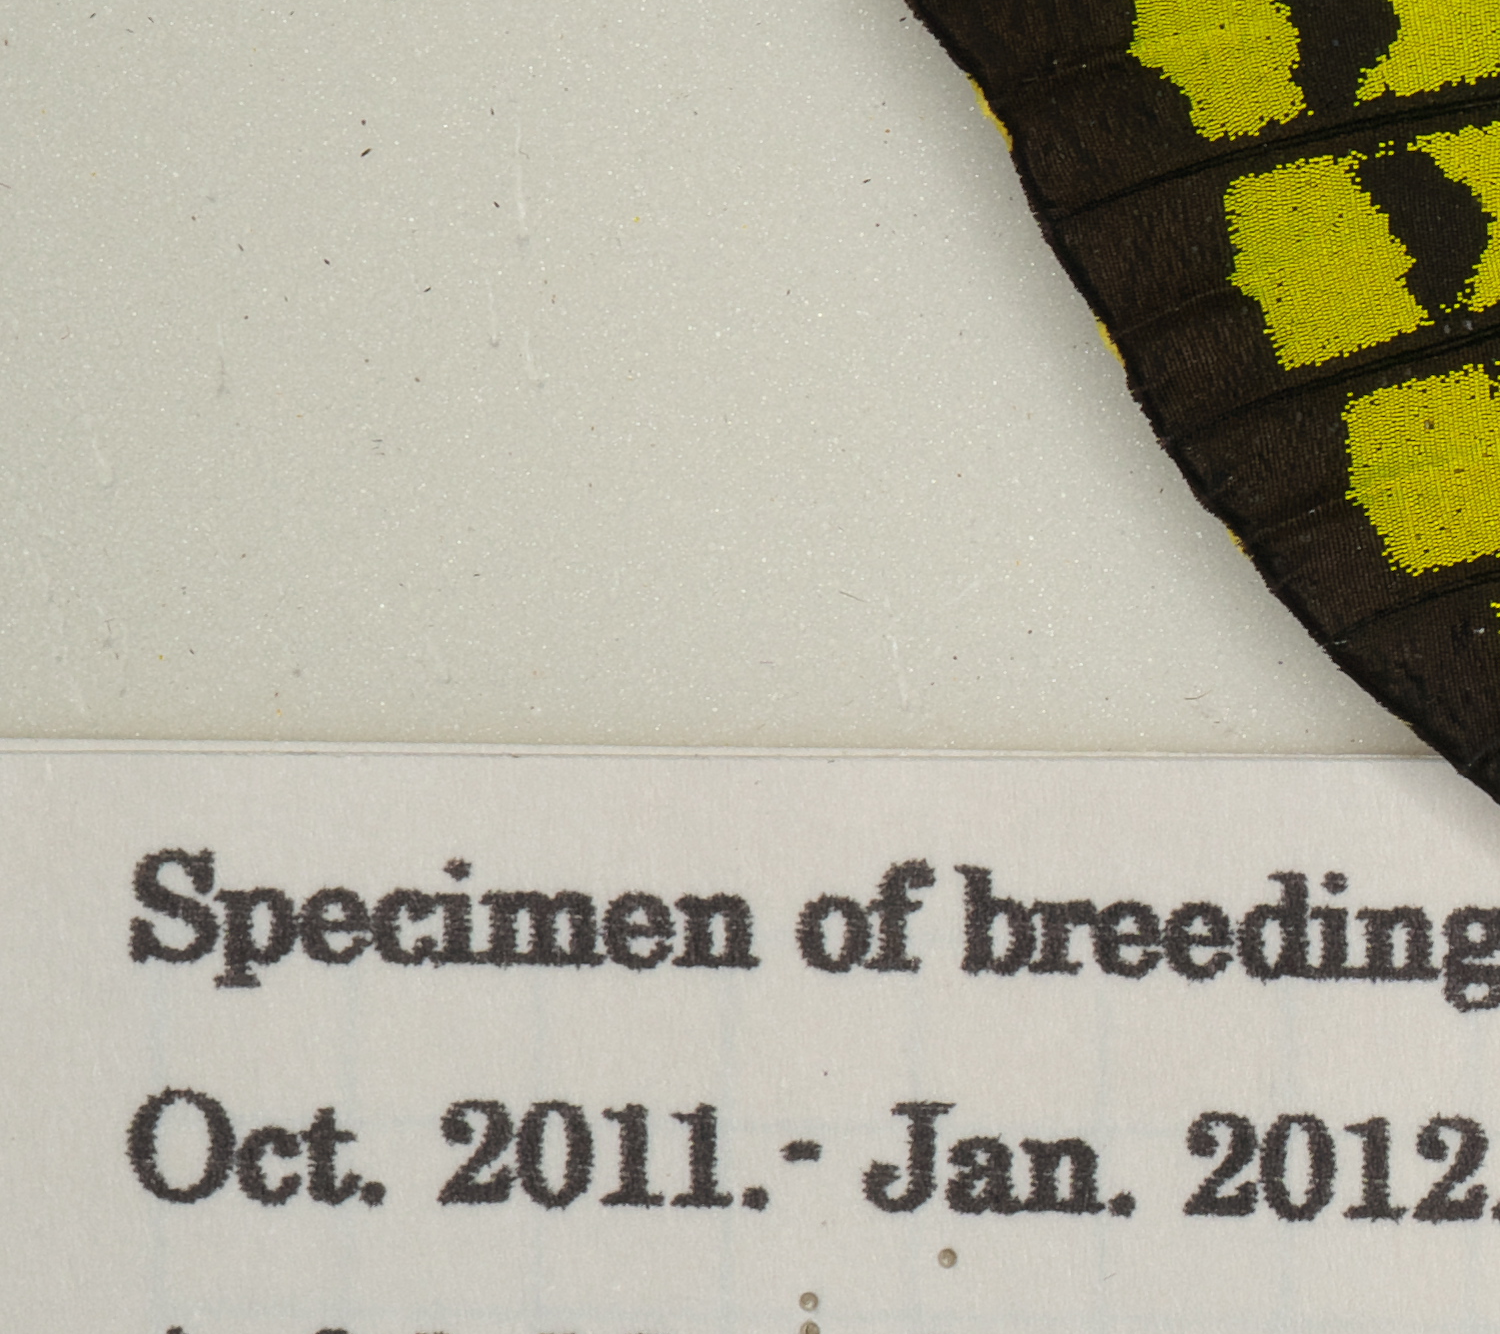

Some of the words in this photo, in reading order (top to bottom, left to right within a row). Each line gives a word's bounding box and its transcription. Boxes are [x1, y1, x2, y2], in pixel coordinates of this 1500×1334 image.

[129, 848, 760, 988] Specimen
[796, 859, 935, 973] of
[126, 1087, 386, 1207] Oct.
[863, 1101, 1135, 1217] Jan.
